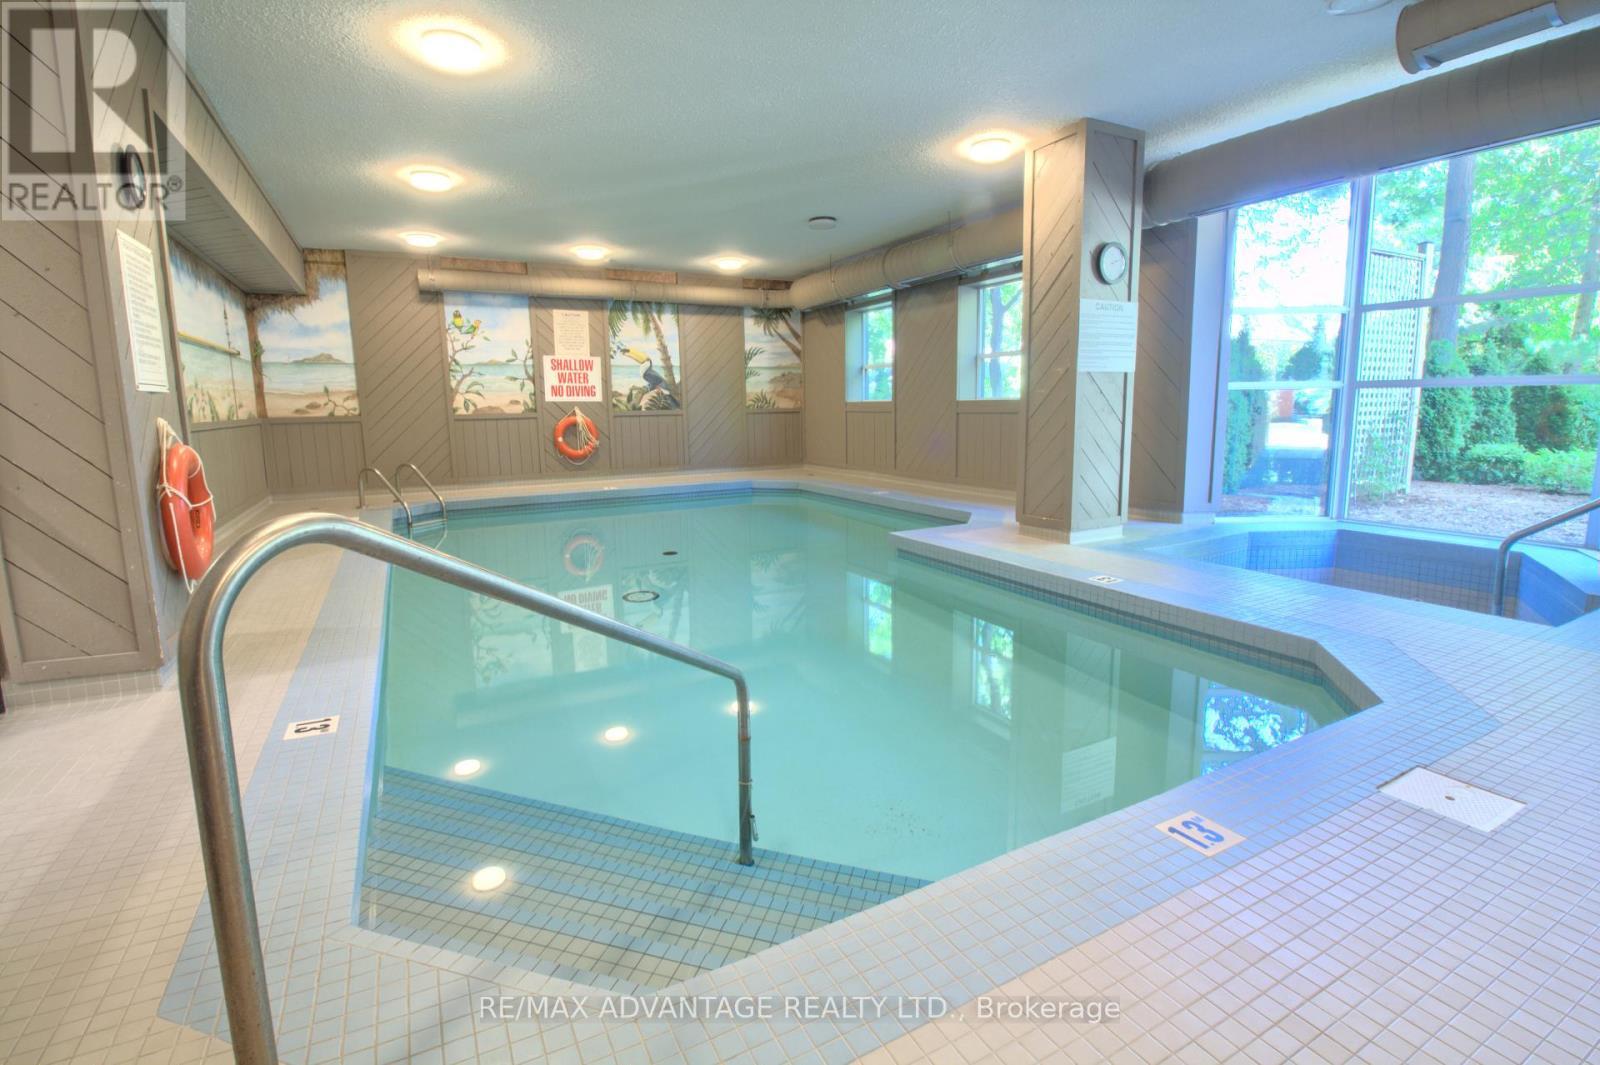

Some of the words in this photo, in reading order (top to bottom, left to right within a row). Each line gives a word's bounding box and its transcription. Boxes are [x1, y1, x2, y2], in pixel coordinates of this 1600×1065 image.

[550, 358, 594, 372] SHALLOW
[557, 372, 589, 384] WATER
[551, 385, 564, 397] NO
[566, 385, 596, 398] DIVING
